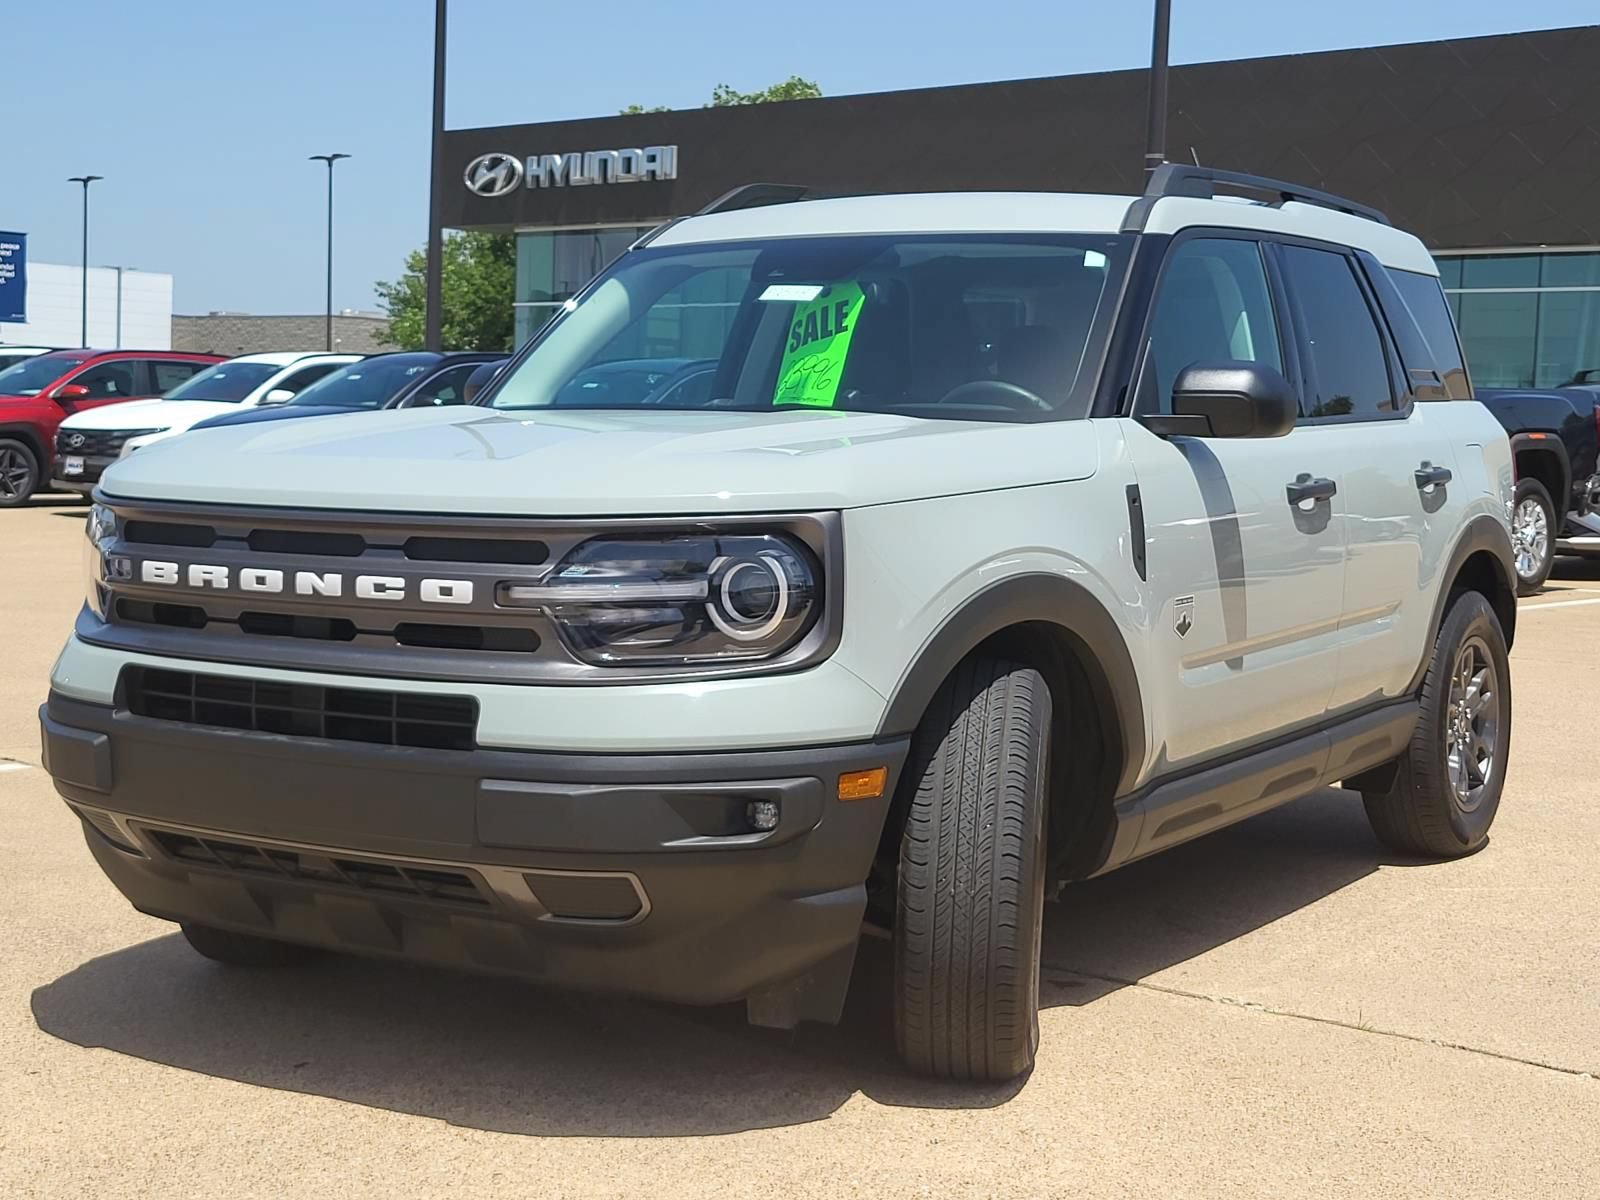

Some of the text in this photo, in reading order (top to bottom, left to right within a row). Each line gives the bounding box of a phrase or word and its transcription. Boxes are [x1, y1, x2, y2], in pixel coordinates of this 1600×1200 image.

[525, 144, 678, 189] HYUNDAI
[789, 299, 849, 354] SALE
[140, 560, 474, 605] BRONCO
